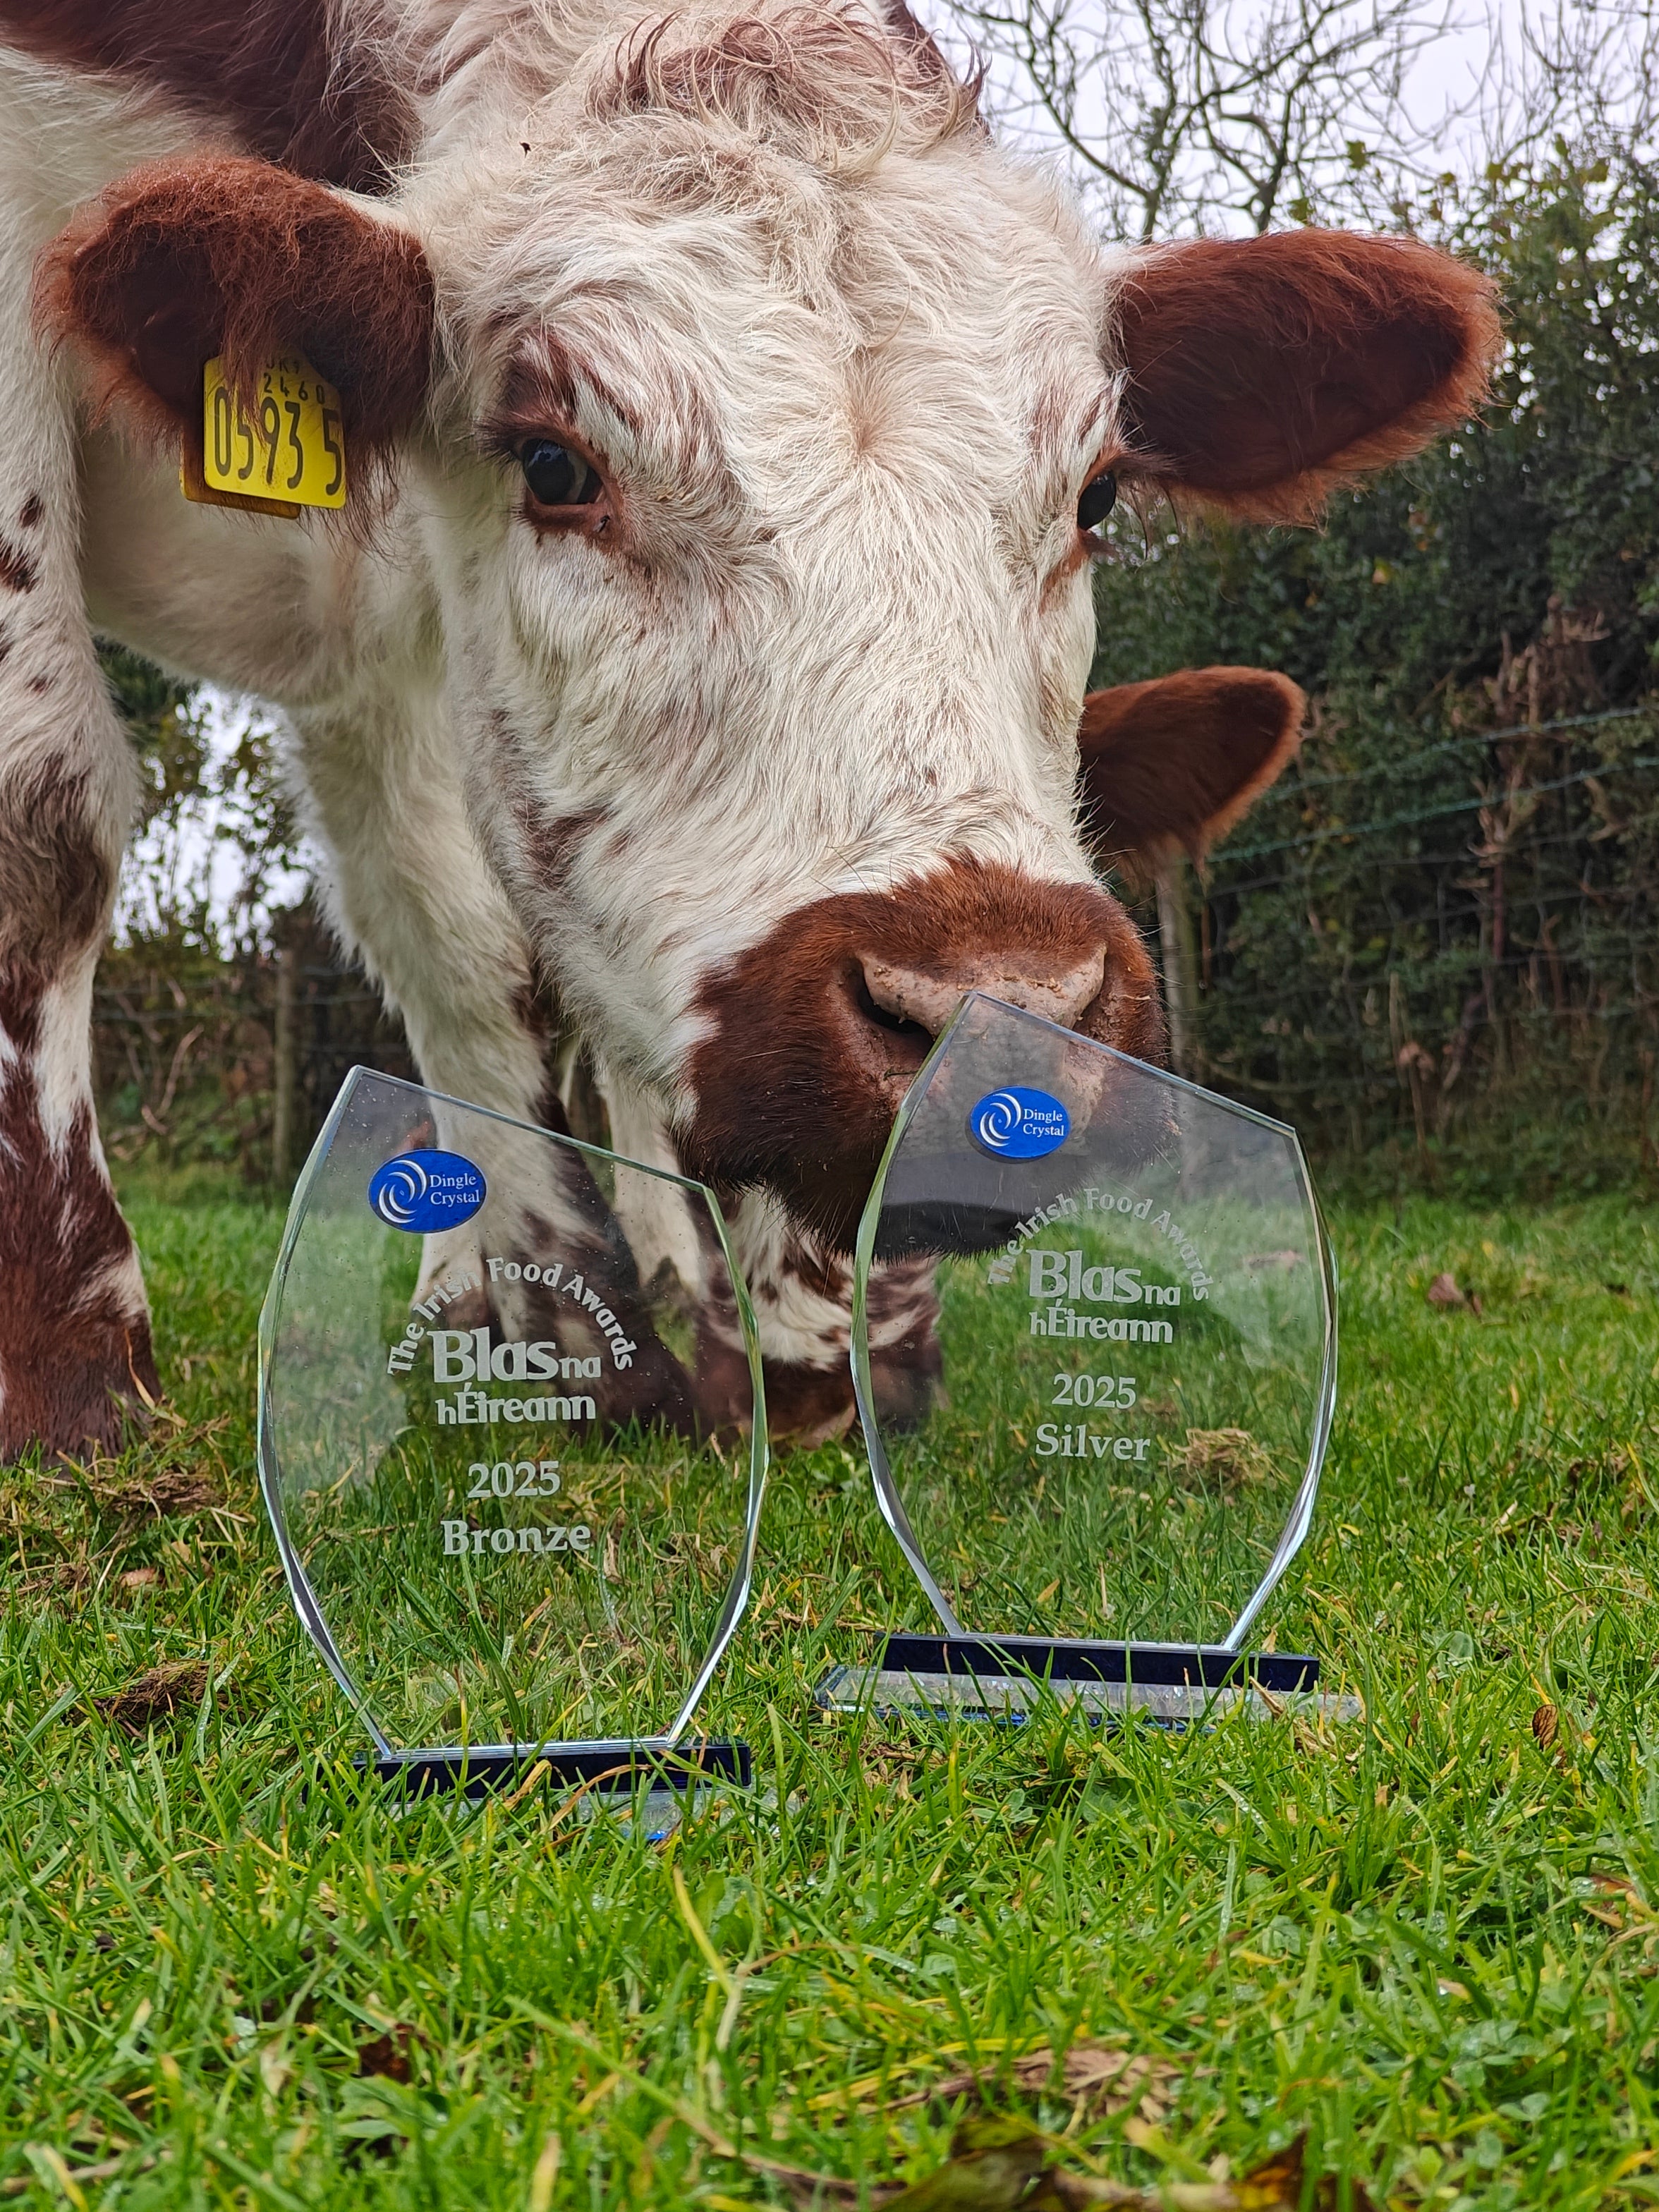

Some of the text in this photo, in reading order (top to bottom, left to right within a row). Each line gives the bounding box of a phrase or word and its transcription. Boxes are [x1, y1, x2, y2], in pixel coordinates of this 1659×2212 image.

[263, 372, 325, 404] 2460
[1023, 1108, 1063, 1123] Dingle
[1023, 1123, 1064, 1137] Crystal
[429, 1172, 477, 1190] Dingle
[430, 1189, 480, 1208] Crystal
[988, 1188, 1213, 1301] The Irish Food Awards
[1026, 1248, 1181, 1306] Blas na
[387, 1258, 637, 1375] The Irish Food Awards
[1028, 1299, 1173, 1344] hÉireann
[426, 1326, 602, 1383] Blas na
[435, 1382, 596, 1424] hÉireann
[1051, 1373, 1136, 1409] 2025
[1035, 1423, 1151, 1461] Silver
[467, 1460, 561, 1499] 2025
[440, 1519, 591, 1555] Bronze
